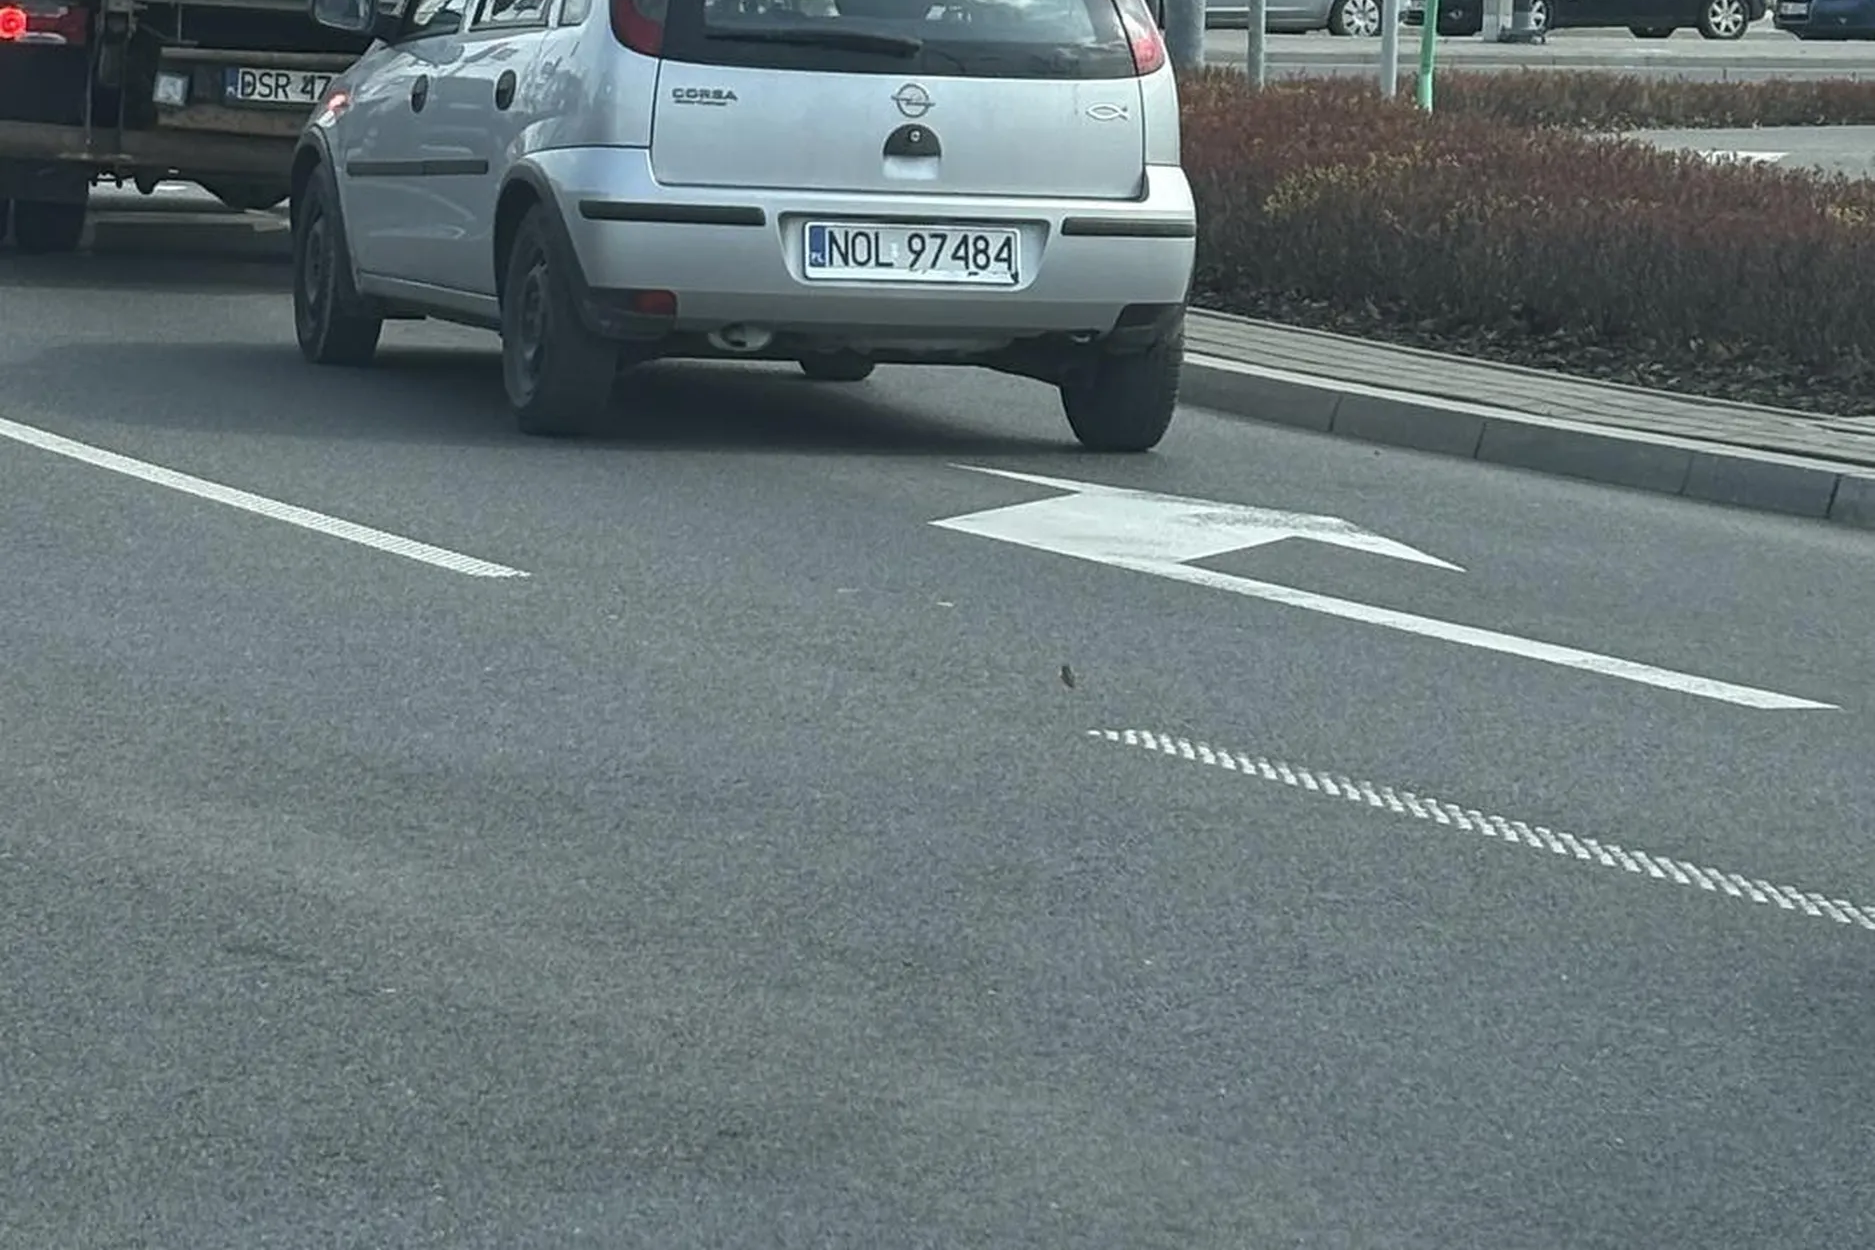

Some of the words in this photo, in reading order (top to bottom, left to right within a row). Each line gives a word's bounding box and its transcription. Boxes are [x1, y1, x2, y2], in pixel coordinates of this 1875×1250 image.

[672, 88, 738, 101] CORSA
[828, 230, 894, 268] NOL
[907, 232, 1013, 272] 97484
